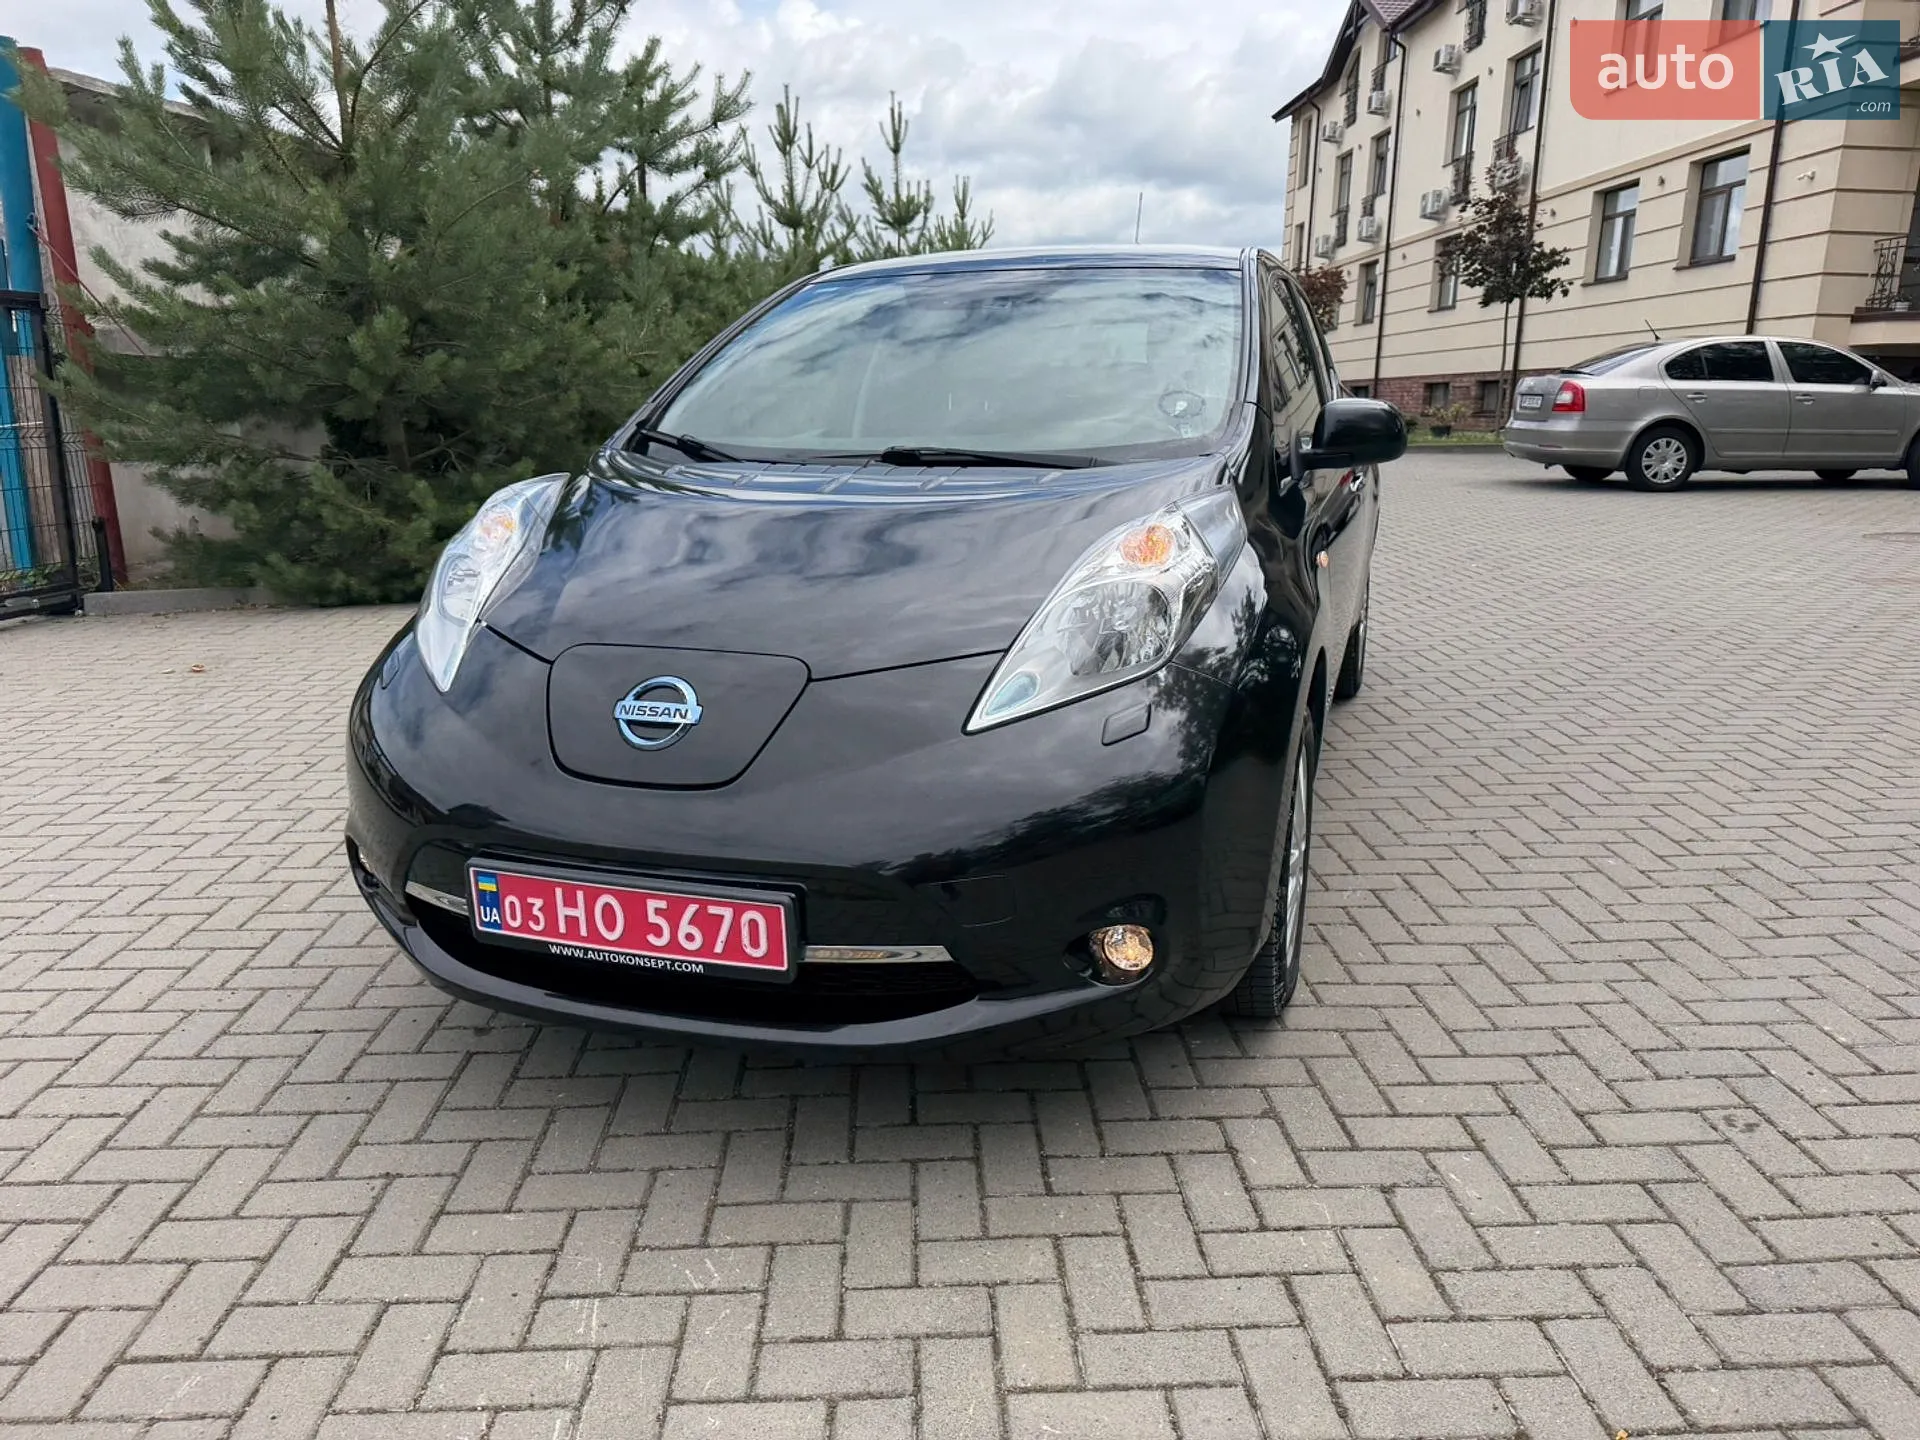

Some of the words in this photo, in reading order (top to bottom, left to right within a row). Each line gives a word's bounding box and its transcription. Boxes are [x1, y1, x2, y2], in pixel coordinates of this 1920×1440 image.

[619, 704, 688, 719] NISSAN
[480, 906, 500, 924] UA
[503, 894, 546, 932] 03
[554, 887, 626, 941] HO
[645, 898, 769, 958] 5670
[548, 943, 705, 974] WWW.AUTOKONSEPT.COM
